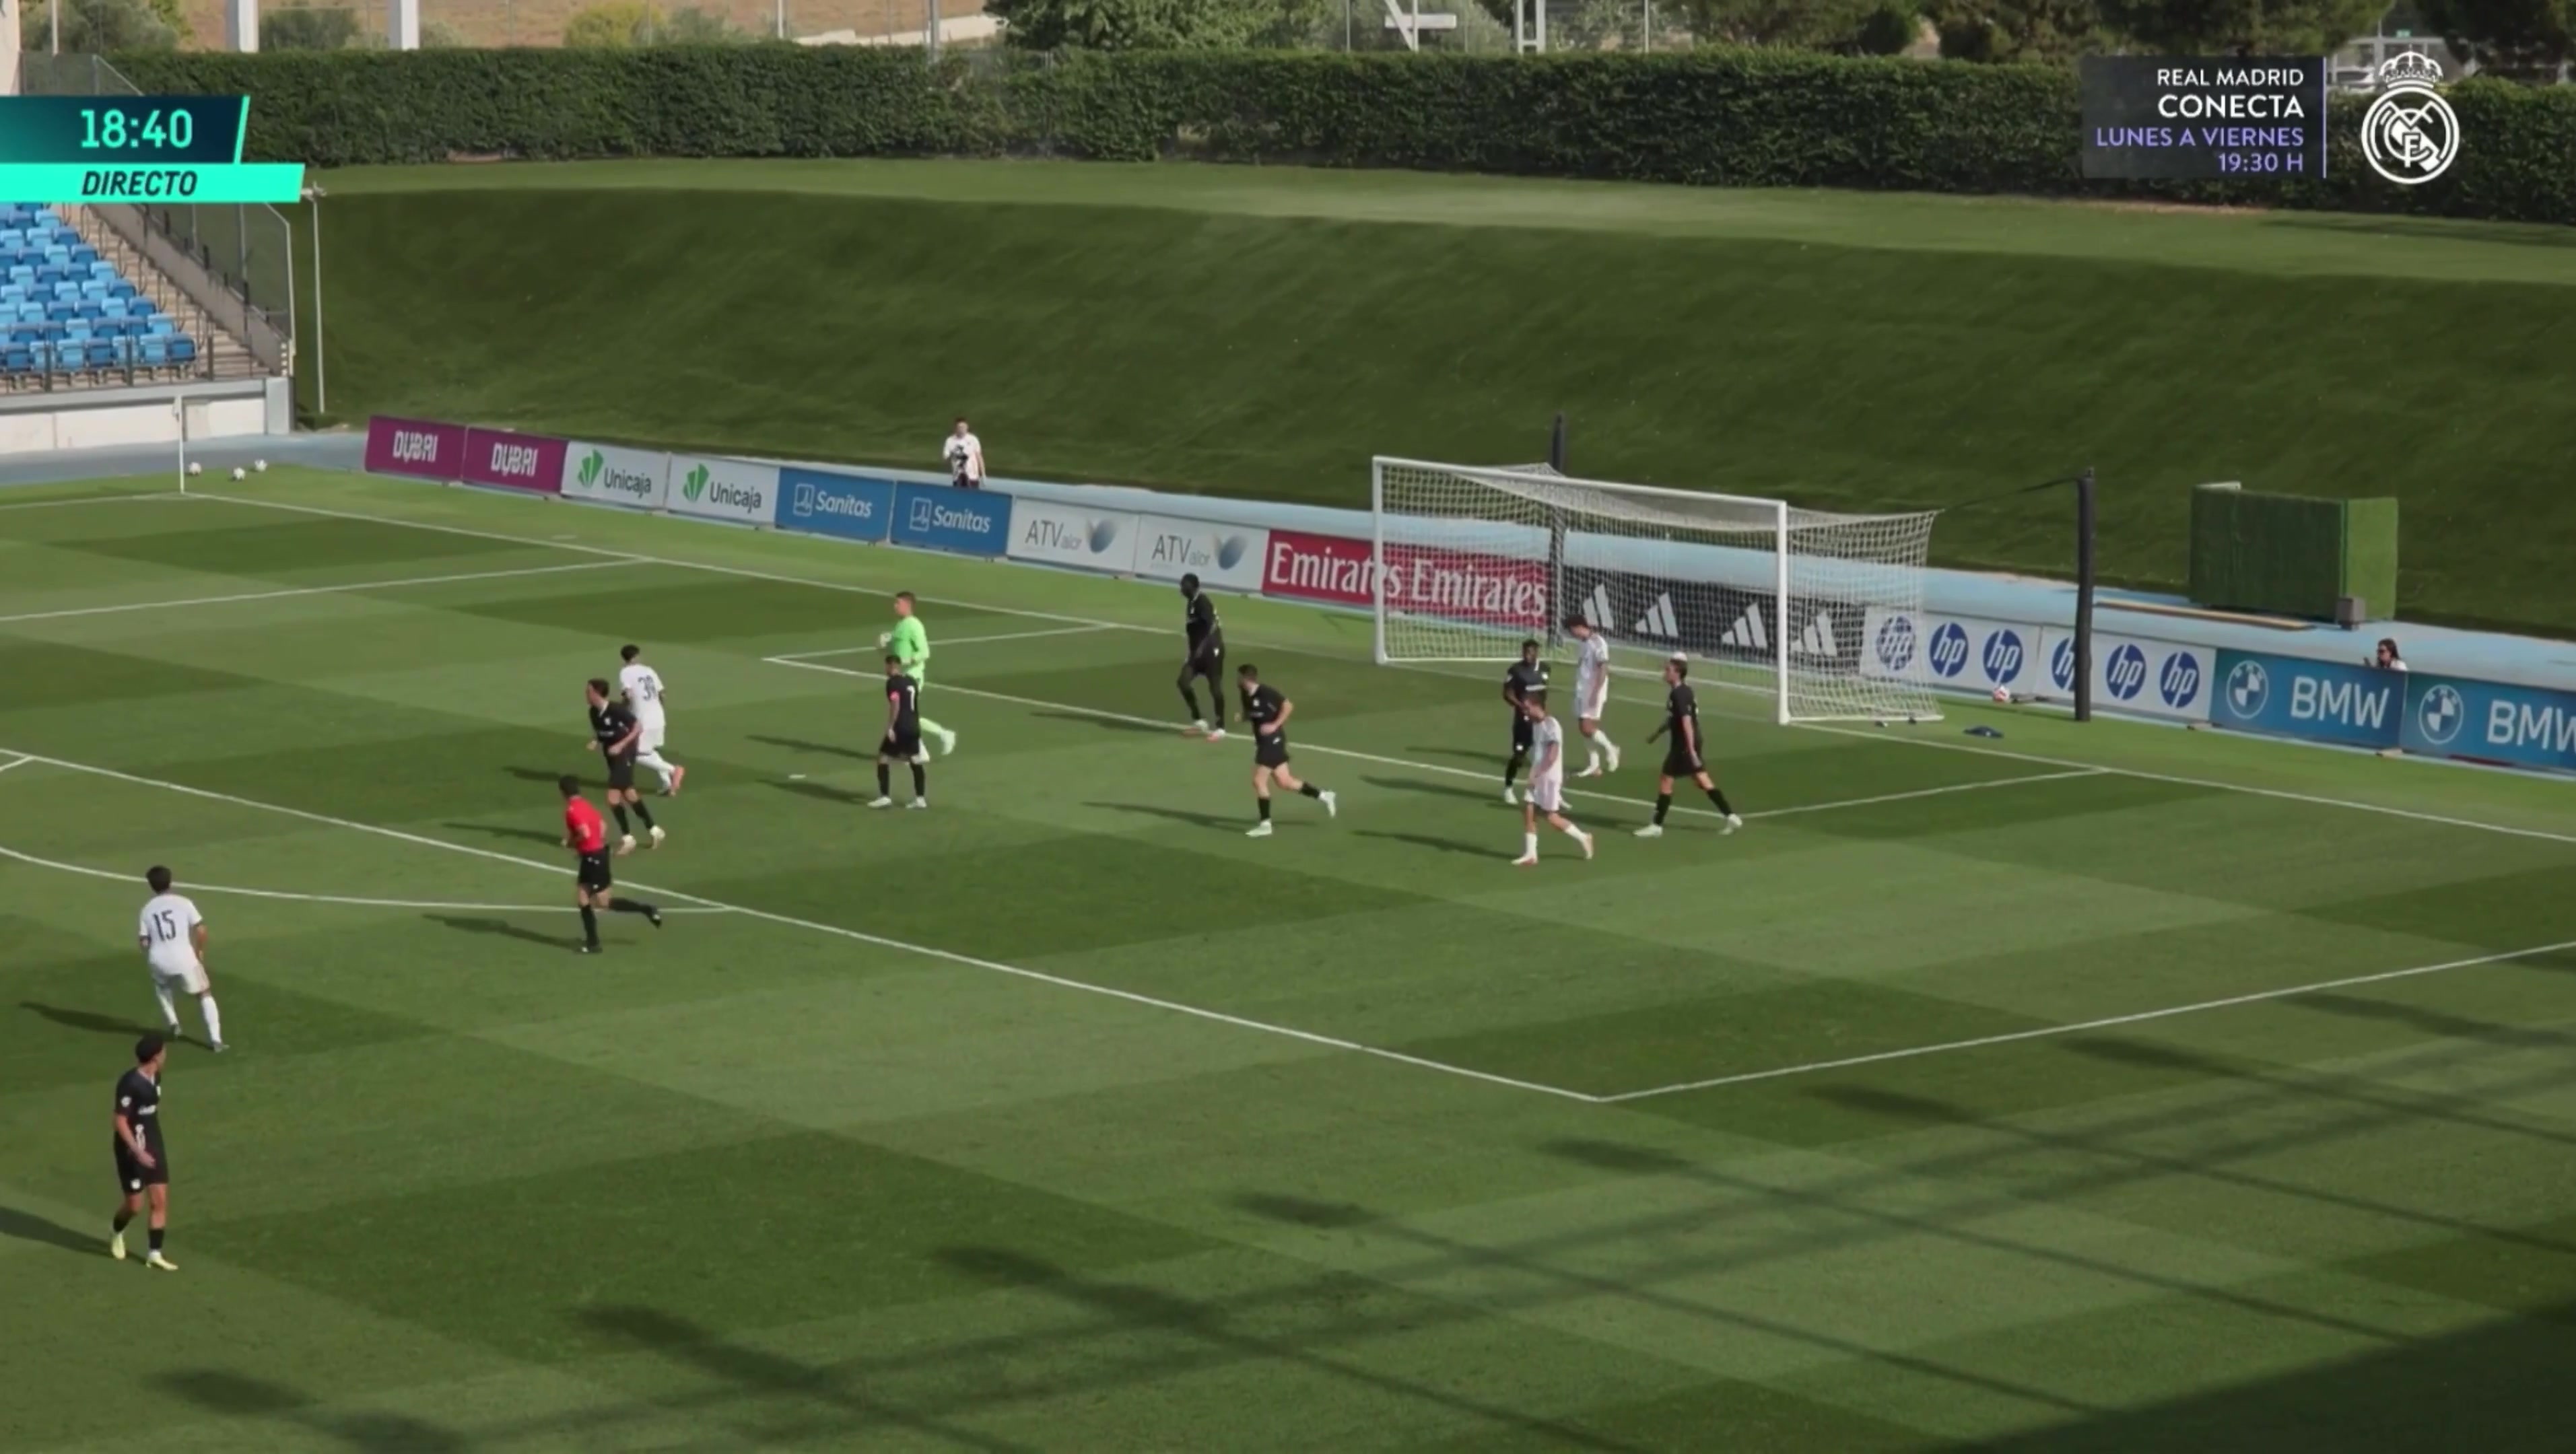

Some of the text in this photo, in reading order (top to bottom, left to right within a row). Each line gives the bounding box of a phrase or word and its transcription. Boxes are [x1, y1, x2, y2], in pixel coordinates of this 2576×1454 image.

[603, 467, 652, 499] Unicaja
[709, 481, 762, 514] Unicaja
[815, 491, 873, 519] Sanitas
[932, 505, 992, 534] Sanitas
[1413, 559, 1547, 617] Emirates
[1932, 623, 1967, 677] hp
[1986, 629, 2021, 684] hp
[2110, 644, 2144, 700] hp
[2164, 652, 2198, 708] hp
[2291, 677, 2389, 729] BMW
[153, 909, 176, 942] 15
